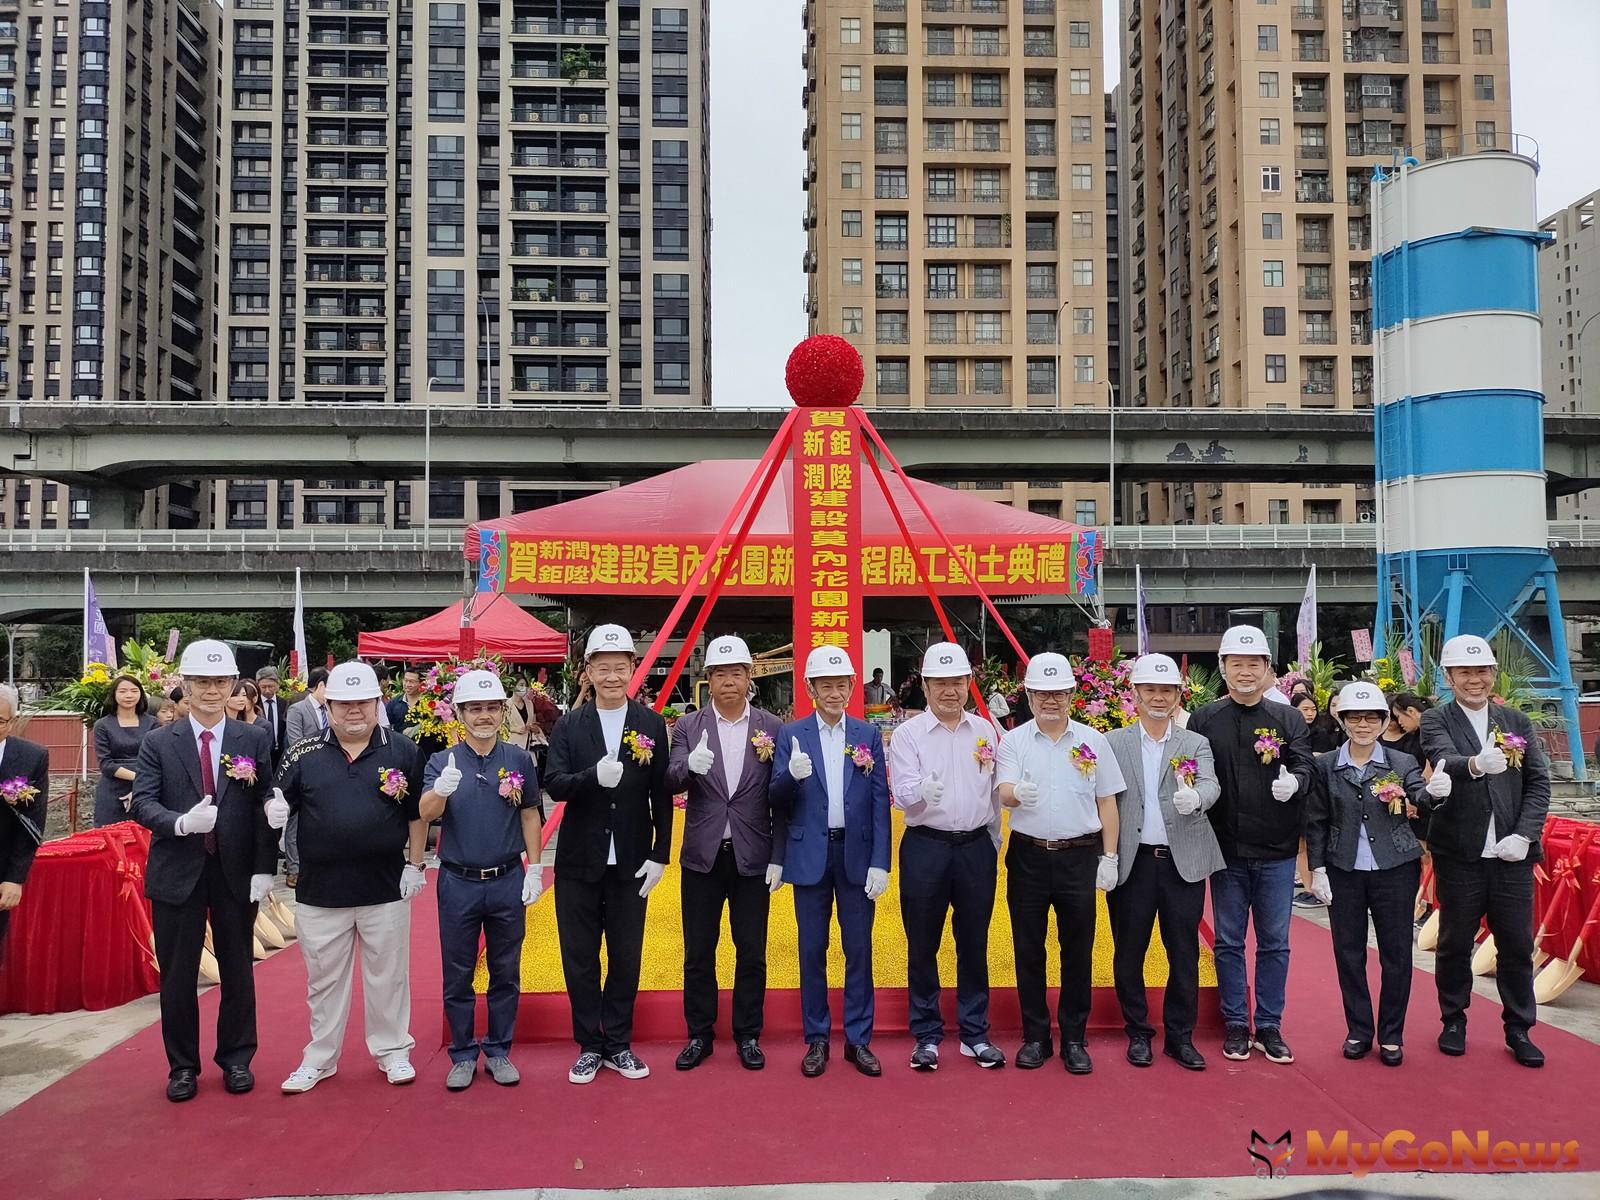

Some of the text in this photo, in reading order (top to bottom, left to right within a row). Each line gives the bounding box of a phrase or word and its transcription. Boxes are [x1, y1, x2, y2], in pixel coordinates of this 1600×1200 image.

[809, 410, 845, 427] 賀
[509, 541, 537, 583] 賀
[539, 540, 590, 560] 新潤
